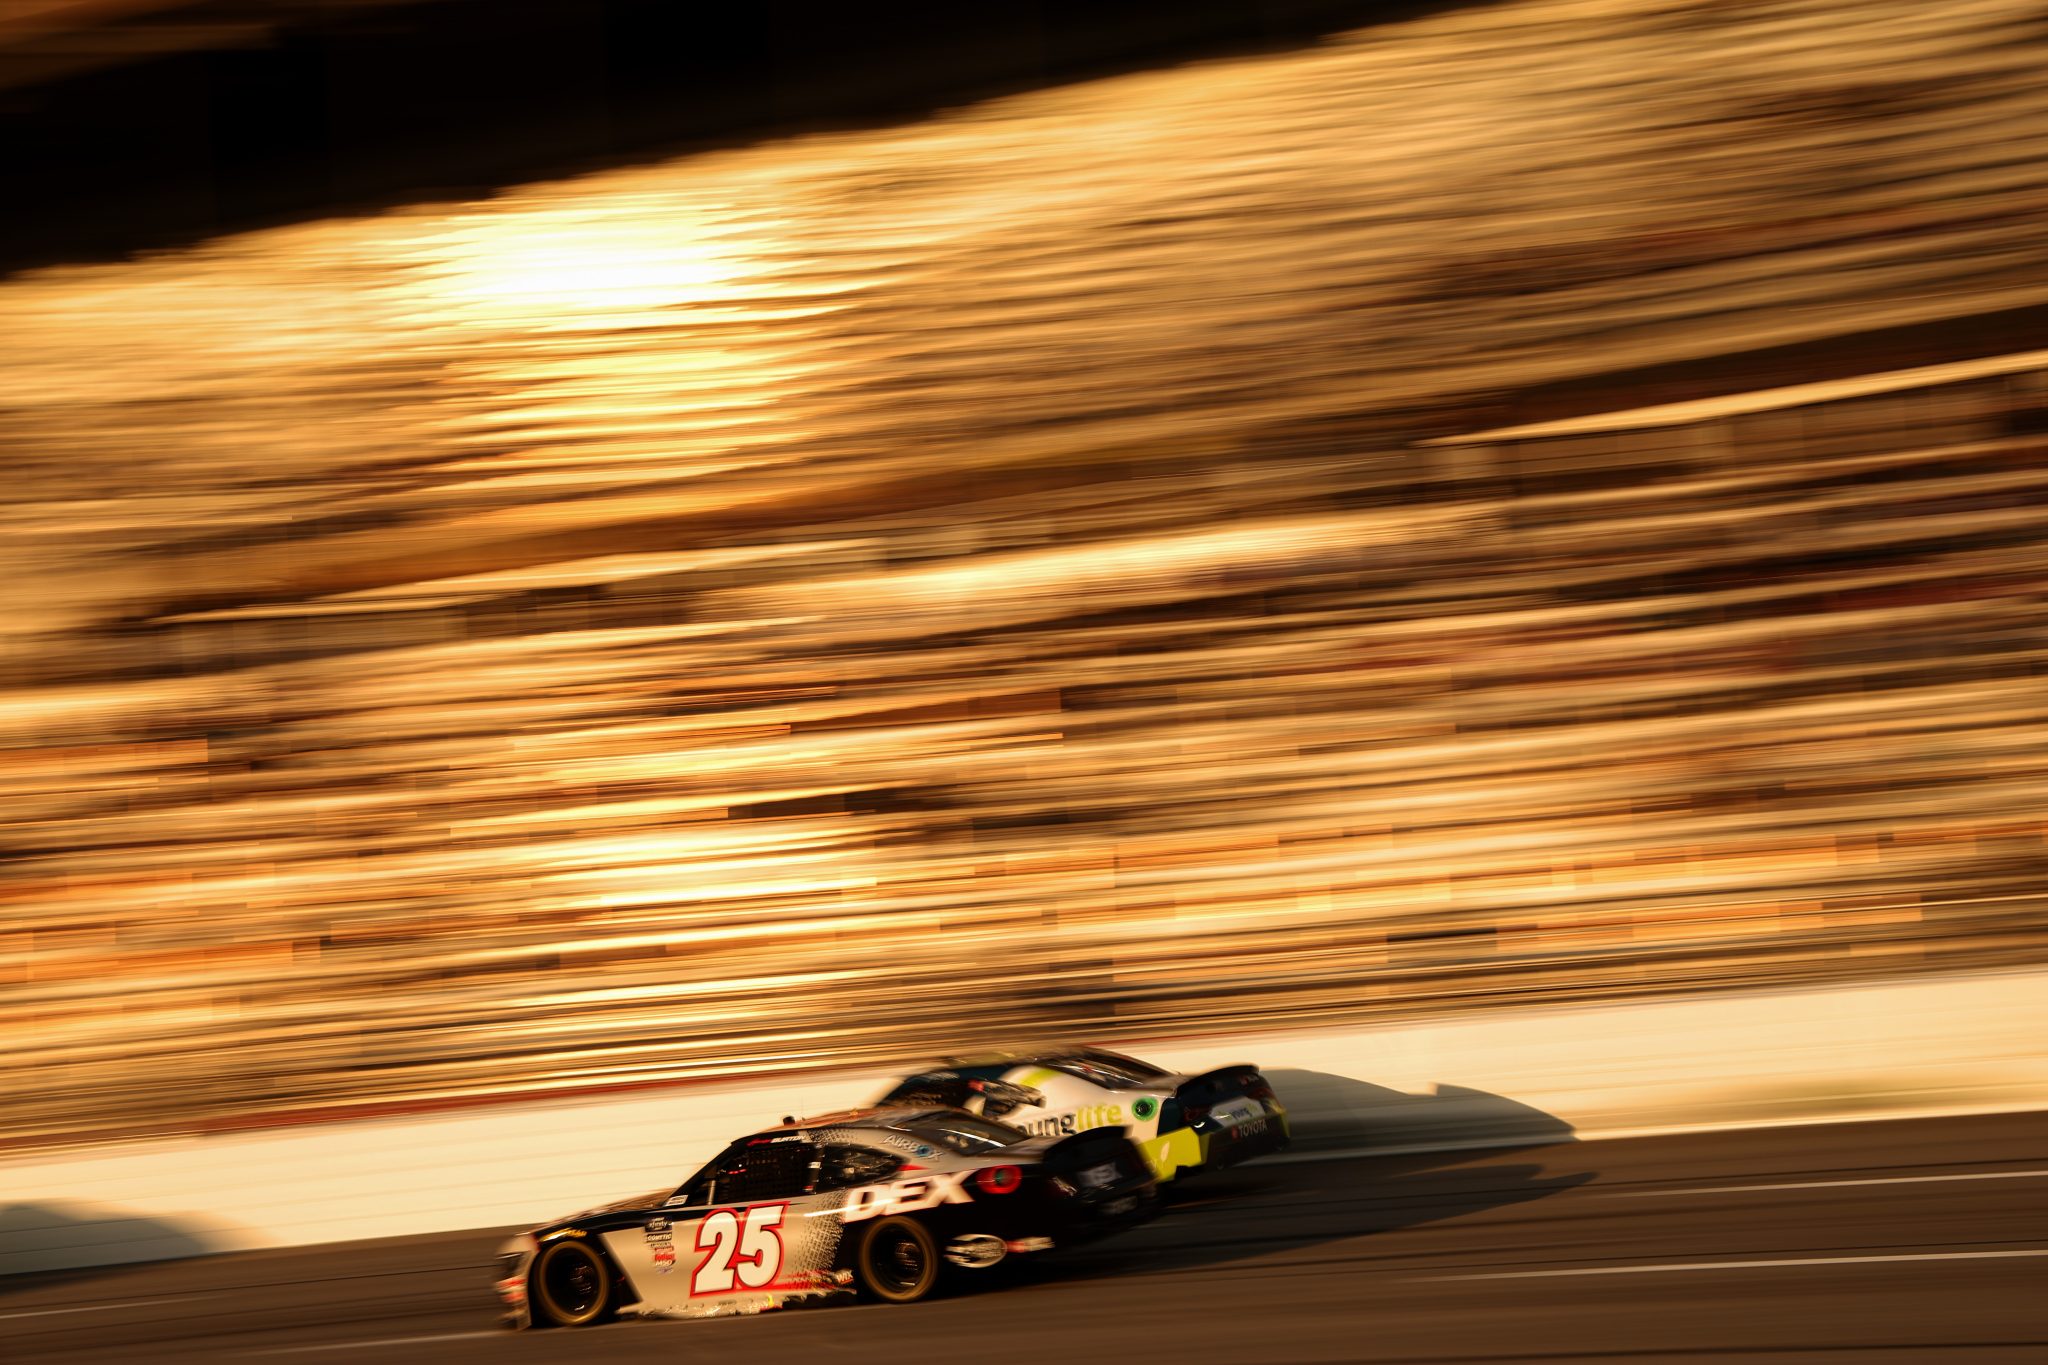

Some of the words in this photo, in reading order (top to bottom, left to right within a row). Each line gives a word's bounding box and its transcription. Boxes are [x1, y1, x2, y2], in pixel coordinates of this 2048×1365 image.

[1239, 1120, 1268, 1137] TOYOTA
[844, 1168, 976, 1223] DEX
[690, 1202, 789, 1297] 25
